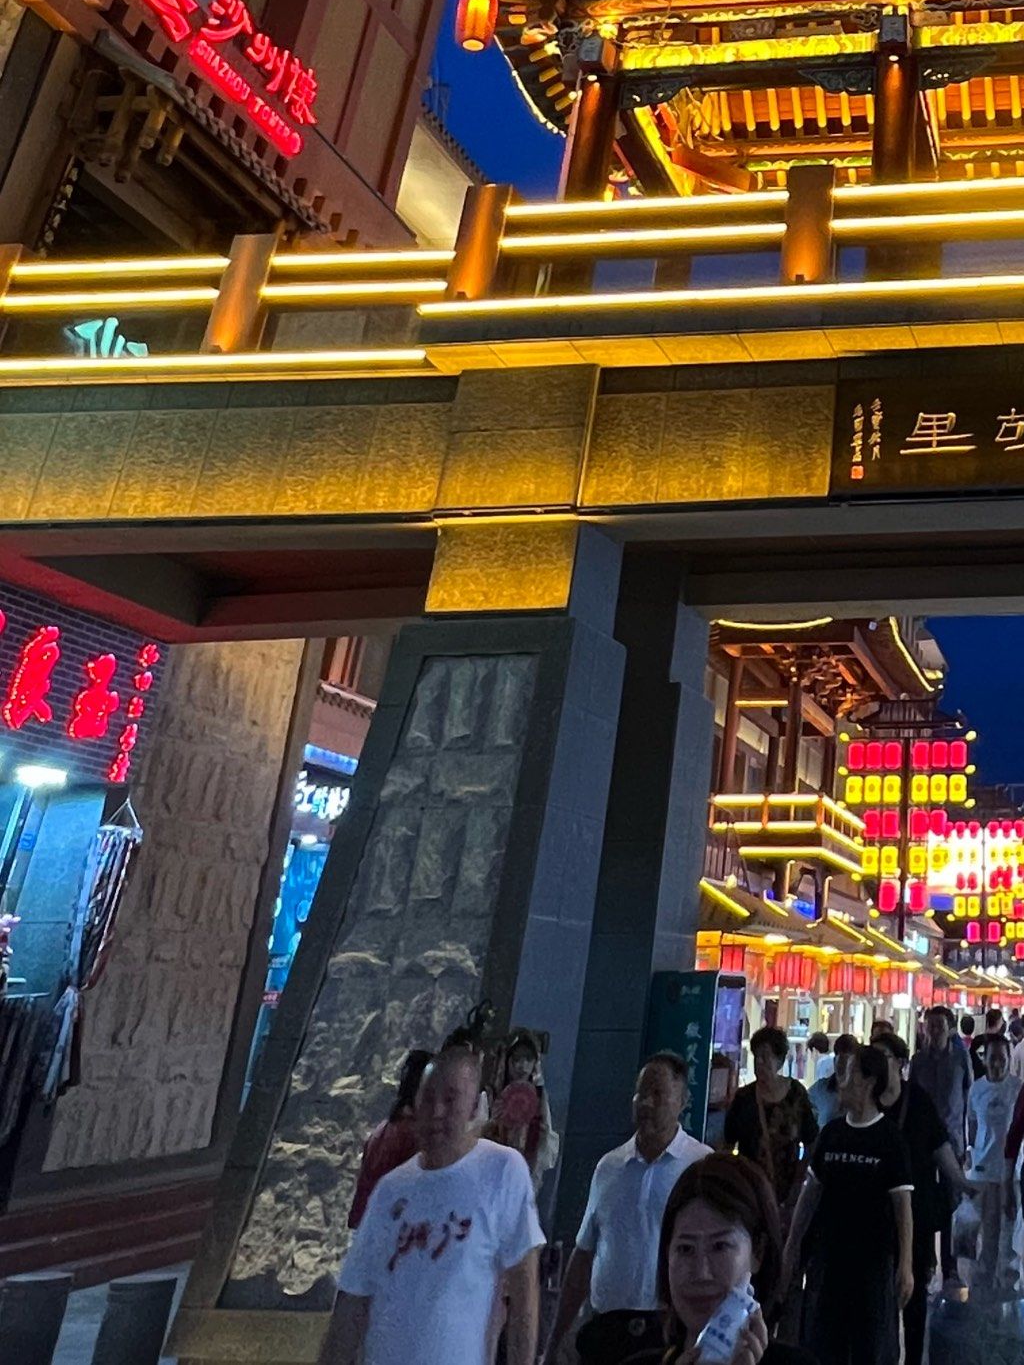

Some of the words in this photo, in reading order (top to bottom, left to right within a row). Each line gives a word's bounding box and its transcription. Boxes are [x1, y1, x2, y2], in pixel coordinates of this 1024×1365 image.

[196, 38, 251, 101] SHAZHOU
[252, 98, 292, 139] TOWER
[824, 1151, 881, 1164] GIVENCHY
